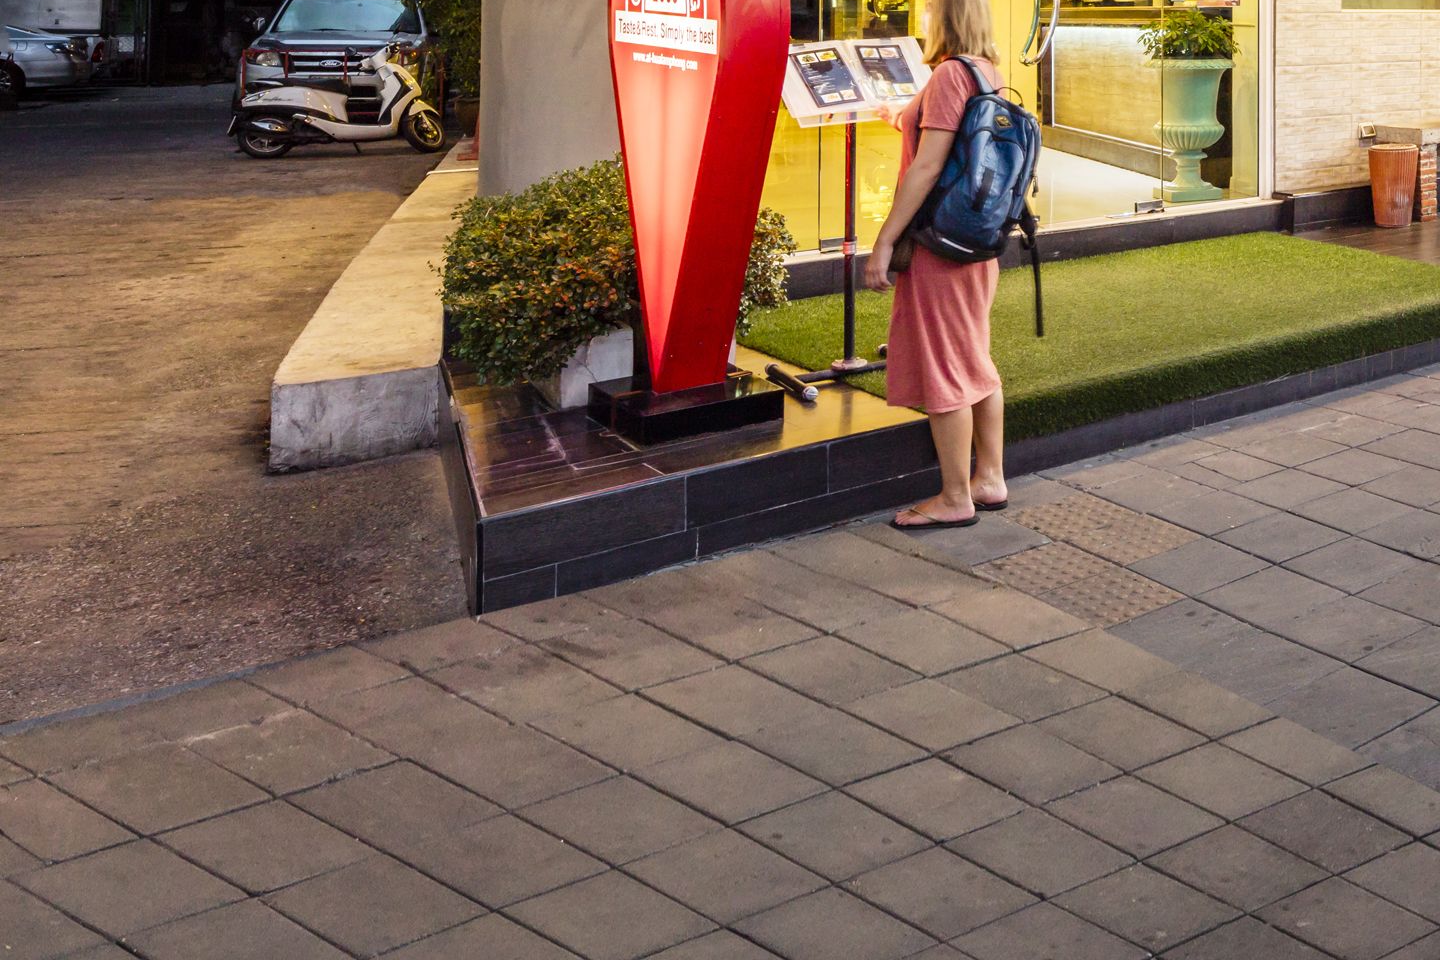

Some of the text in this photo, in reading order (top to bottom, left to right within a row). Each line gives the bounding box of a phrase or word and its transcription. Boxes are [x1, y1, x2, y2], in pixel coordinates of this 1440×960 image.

[660, 22, 685, 44] Simply
[686, 26, 697, 41] the
[699, 28, 715, 45] best
